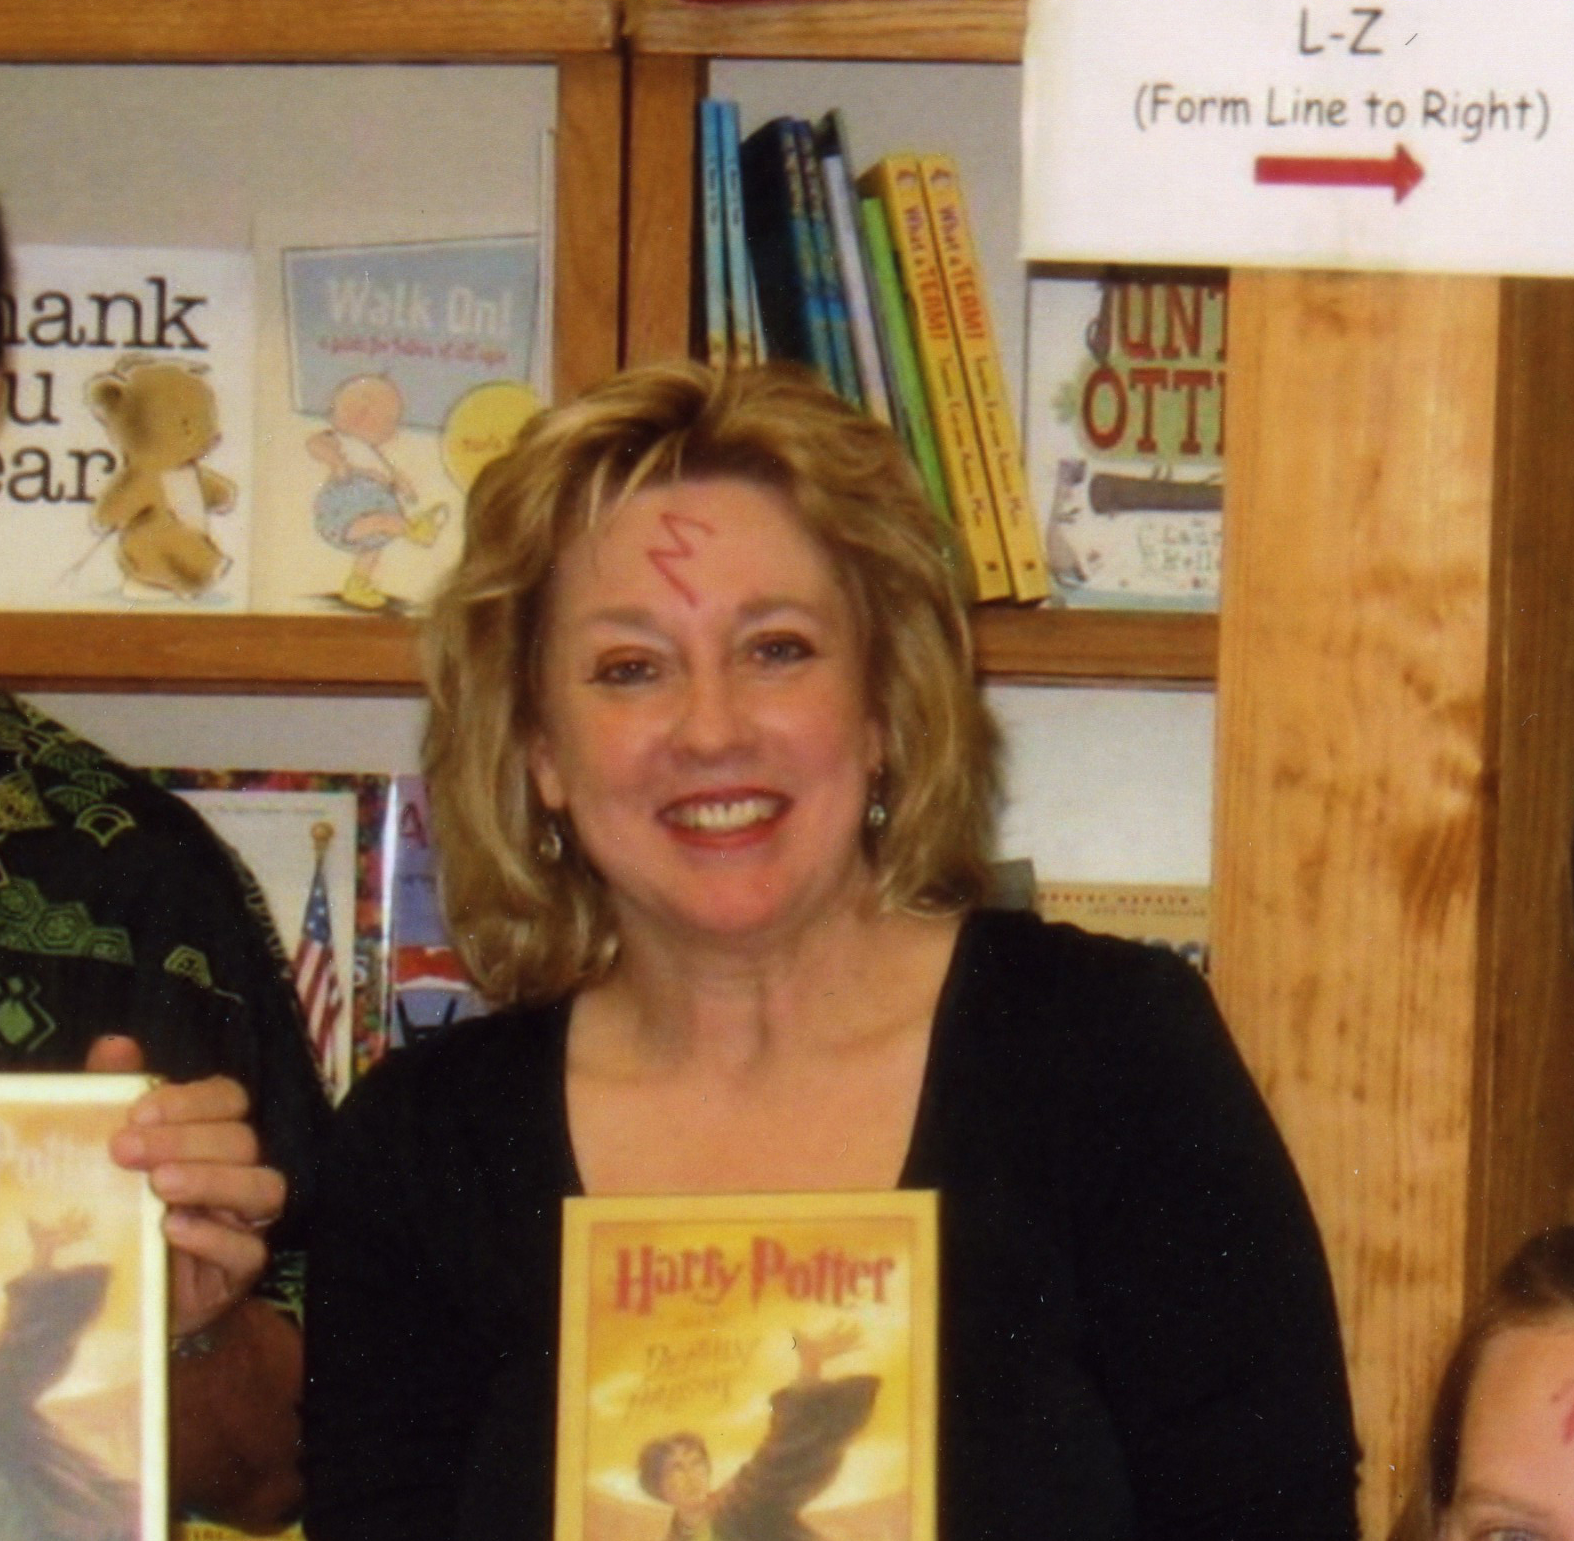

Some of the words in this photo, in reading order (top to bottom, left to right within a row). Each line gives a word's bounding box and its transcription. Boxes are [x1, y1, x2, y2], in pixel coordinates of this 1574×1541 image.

[1298, 7, 1385, 56] L-Z
[1134, 83, 1252, 132] (Form
[1266, 86, 1348, 128] Line
[1369, 90, 1407, 129] to
[1421, 89, 1551, 143] Right)
[326, 278, 434, 333] Walk
[614, 1243, 743, 1317] Harry
[751, 1235, 895, 1313] Potter
